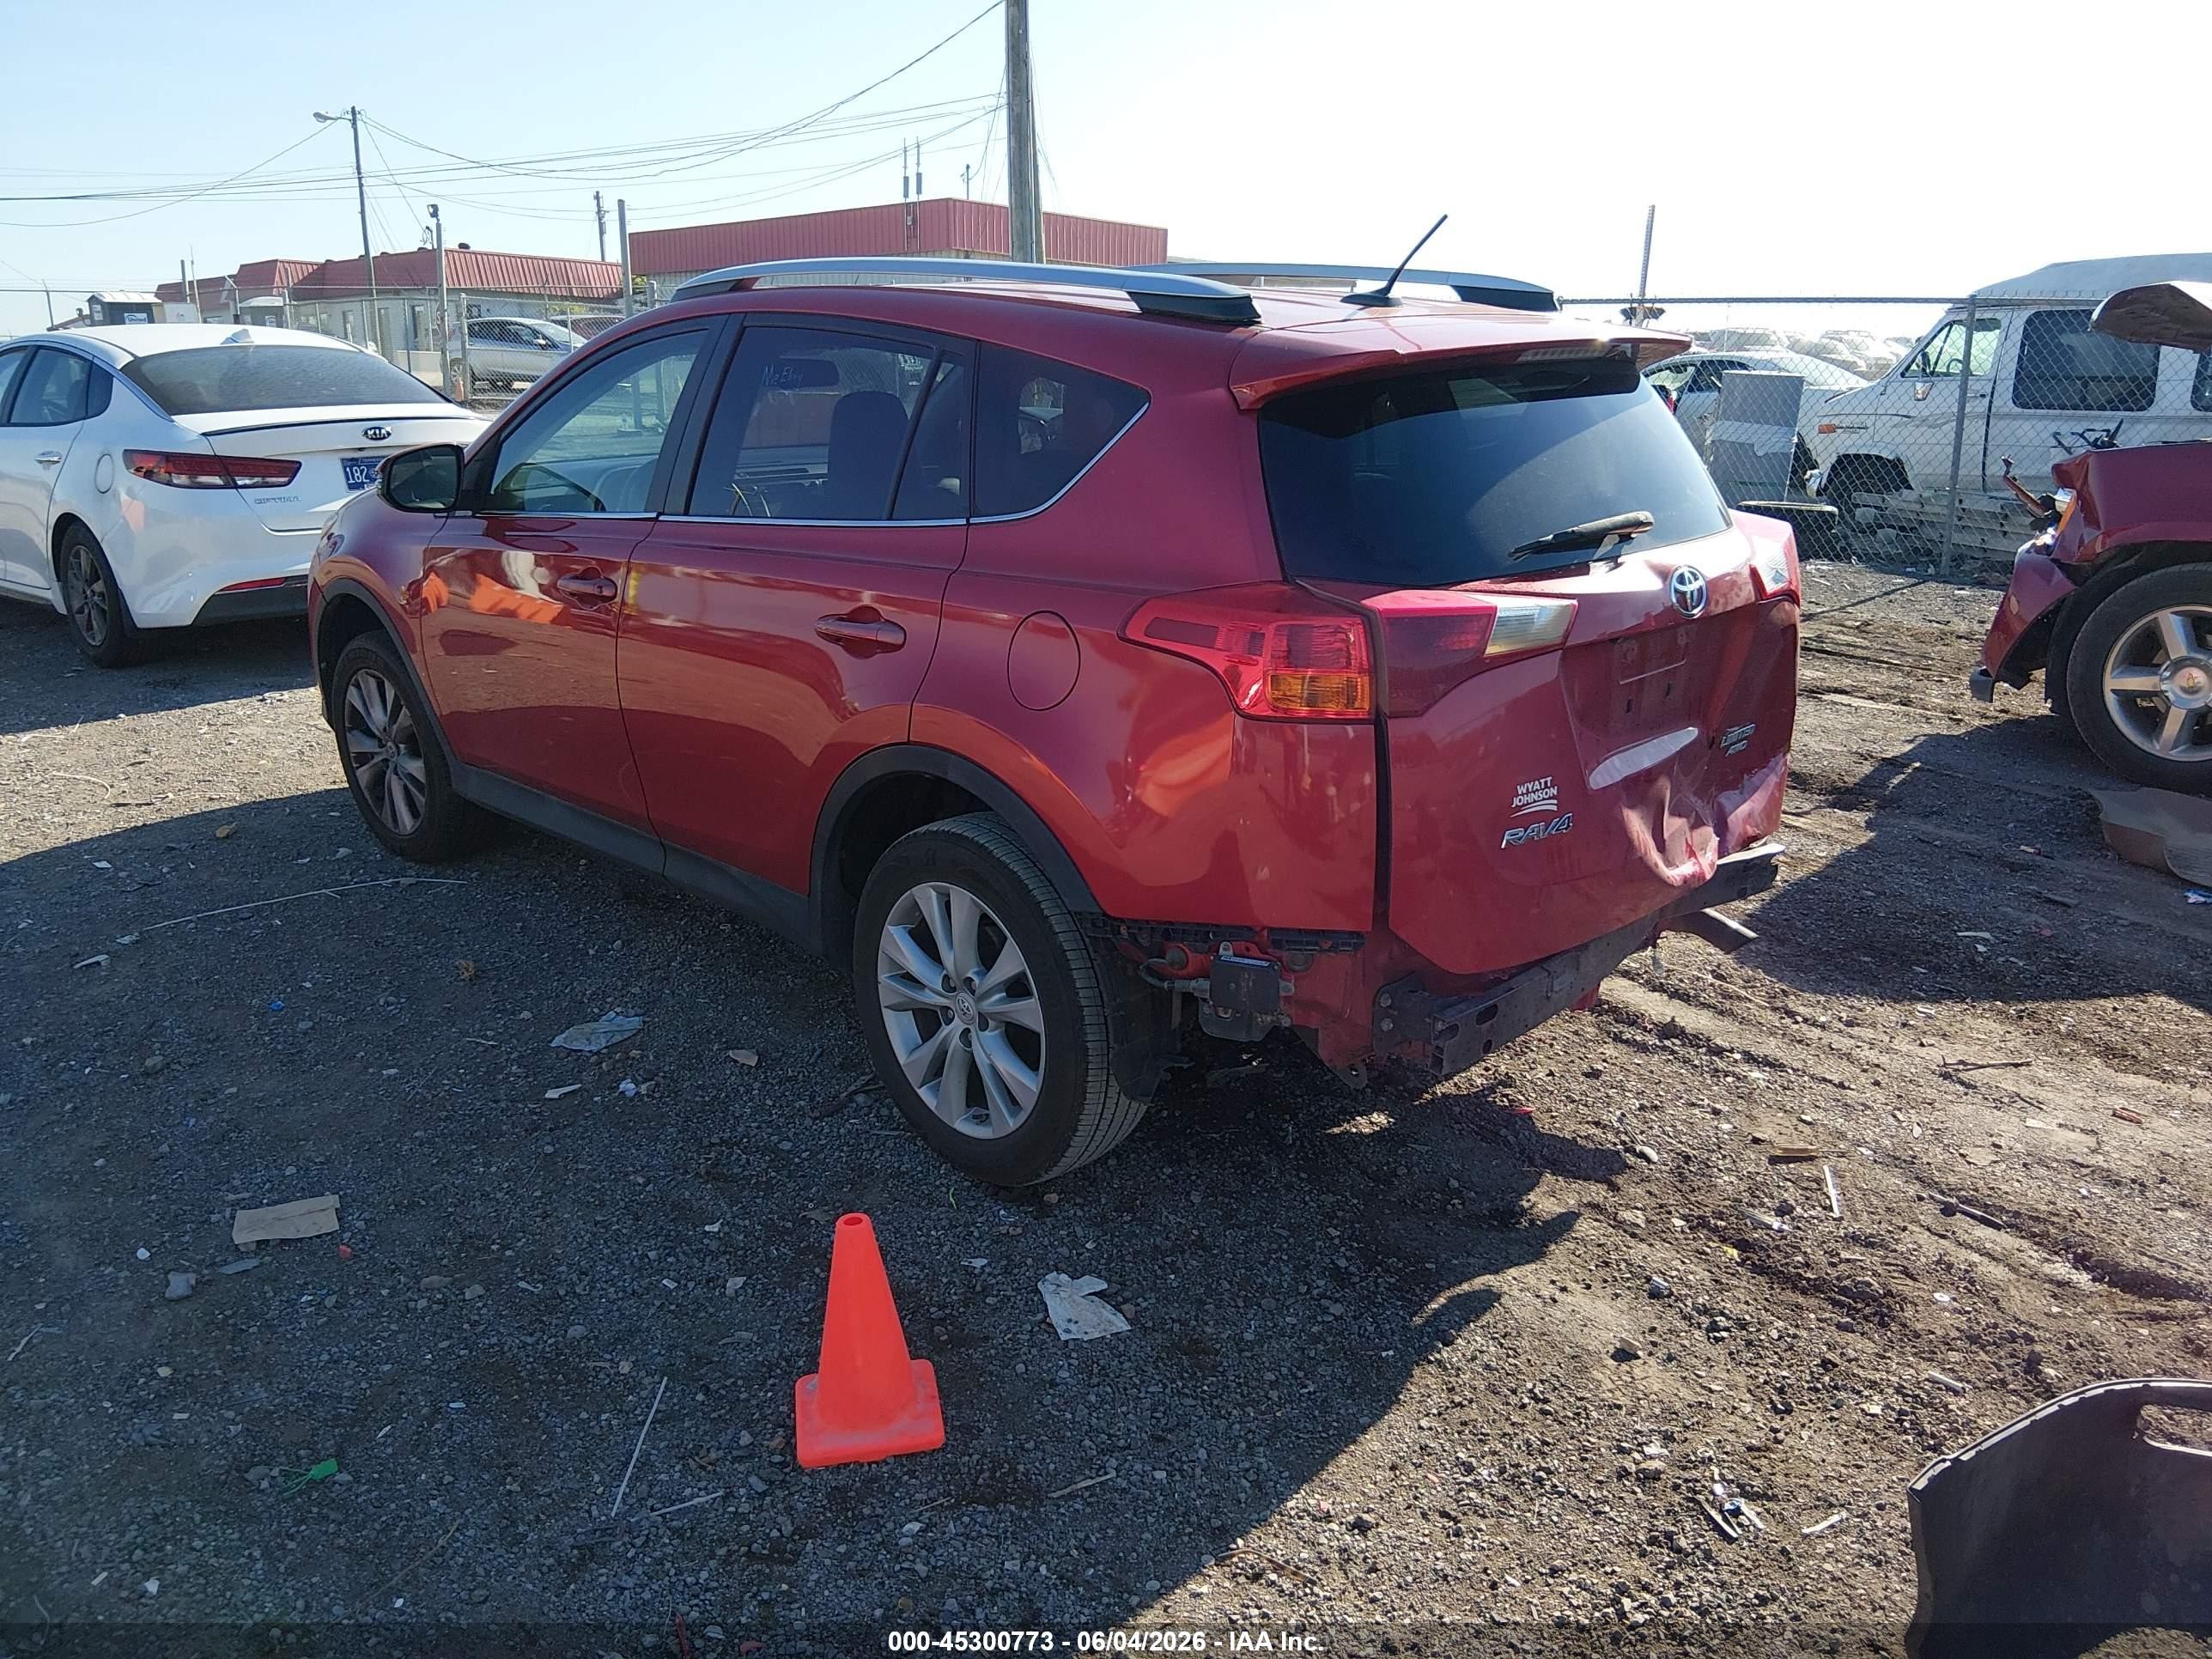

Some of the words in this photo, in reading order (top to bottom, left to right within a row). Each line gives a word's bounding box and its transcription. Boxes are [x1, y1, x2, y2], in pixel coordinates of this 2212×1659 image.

[346, 465, 370, 484] 182
[1516, 776, 1553, 795] WYATT
[1511, 786, 1558, 807] JOHNSON
[1500, 812, 1573, 848] RAV4
